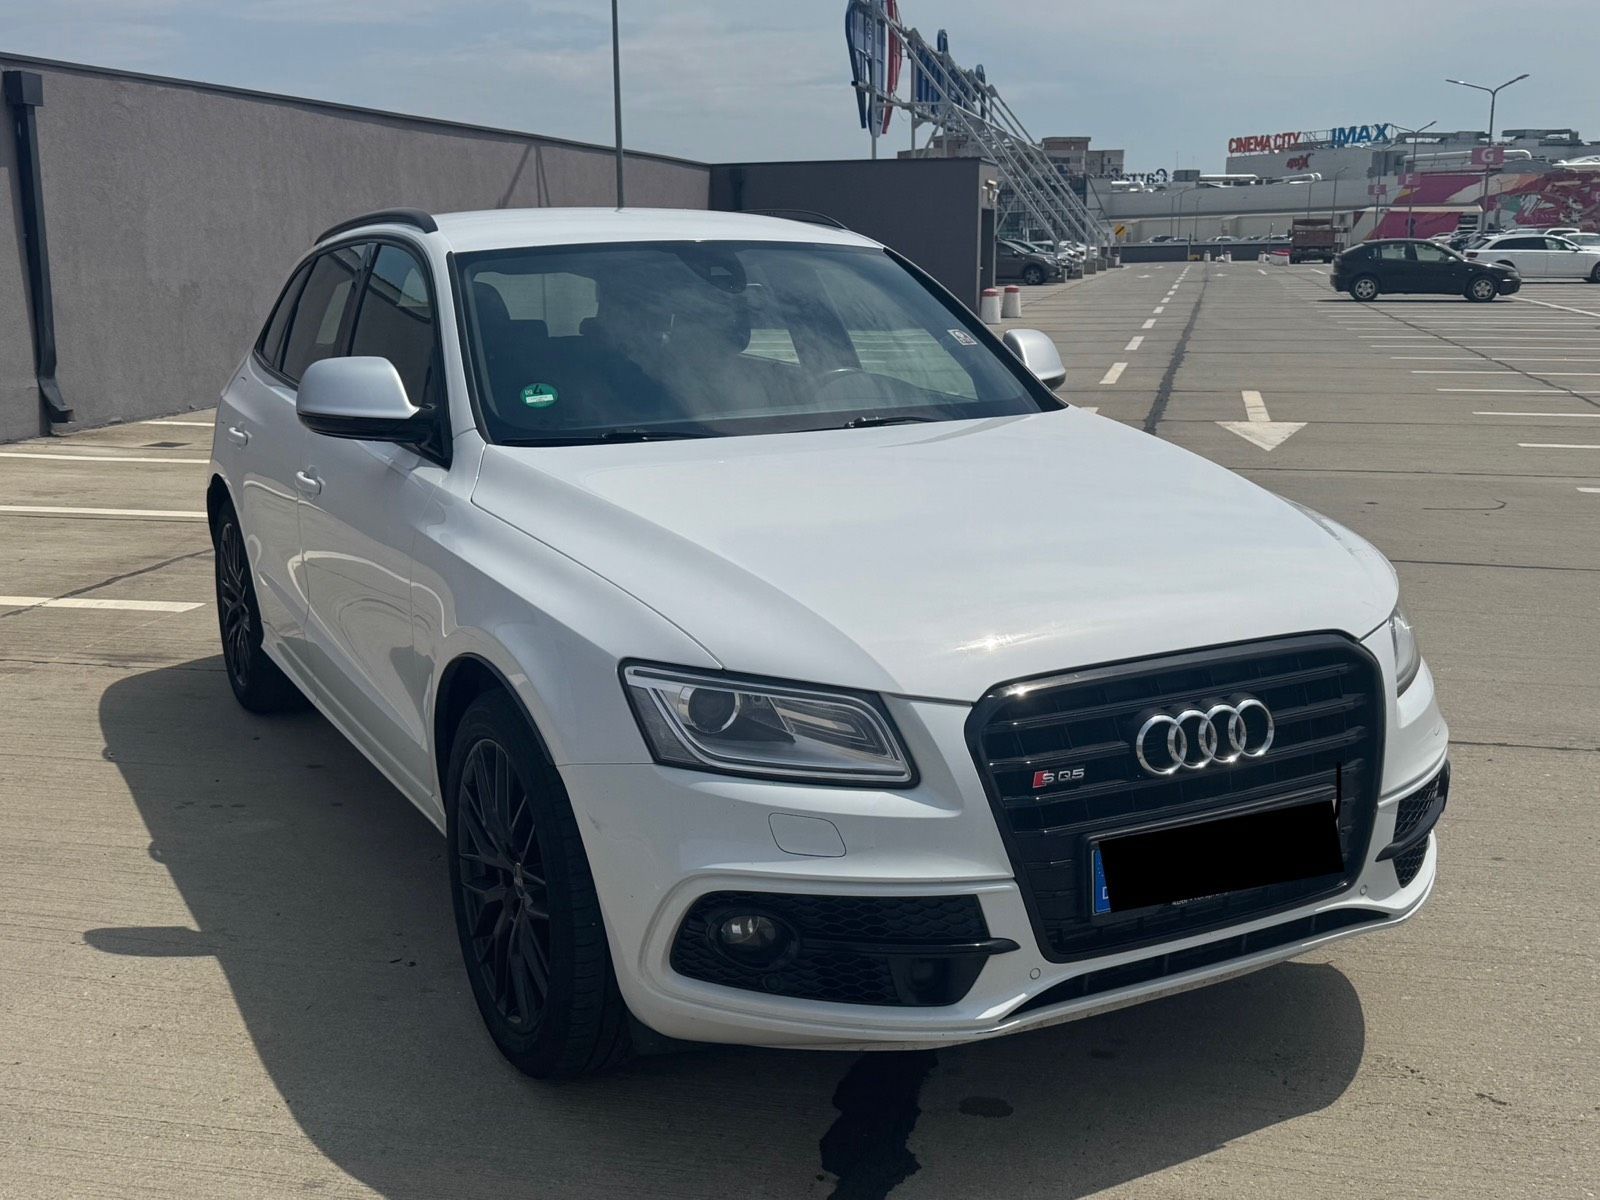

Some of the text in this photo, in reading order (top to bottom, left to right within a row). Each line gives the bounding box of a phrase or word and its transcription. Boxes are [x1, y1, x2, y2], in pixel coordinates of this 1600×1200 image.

[1229, 131, 1302, 153] CINEMA CITY
[1331, 123, 1389, 147] IMAX
[1481, 148, 1495, 162] G
[533, 384, 544, 395] 4
